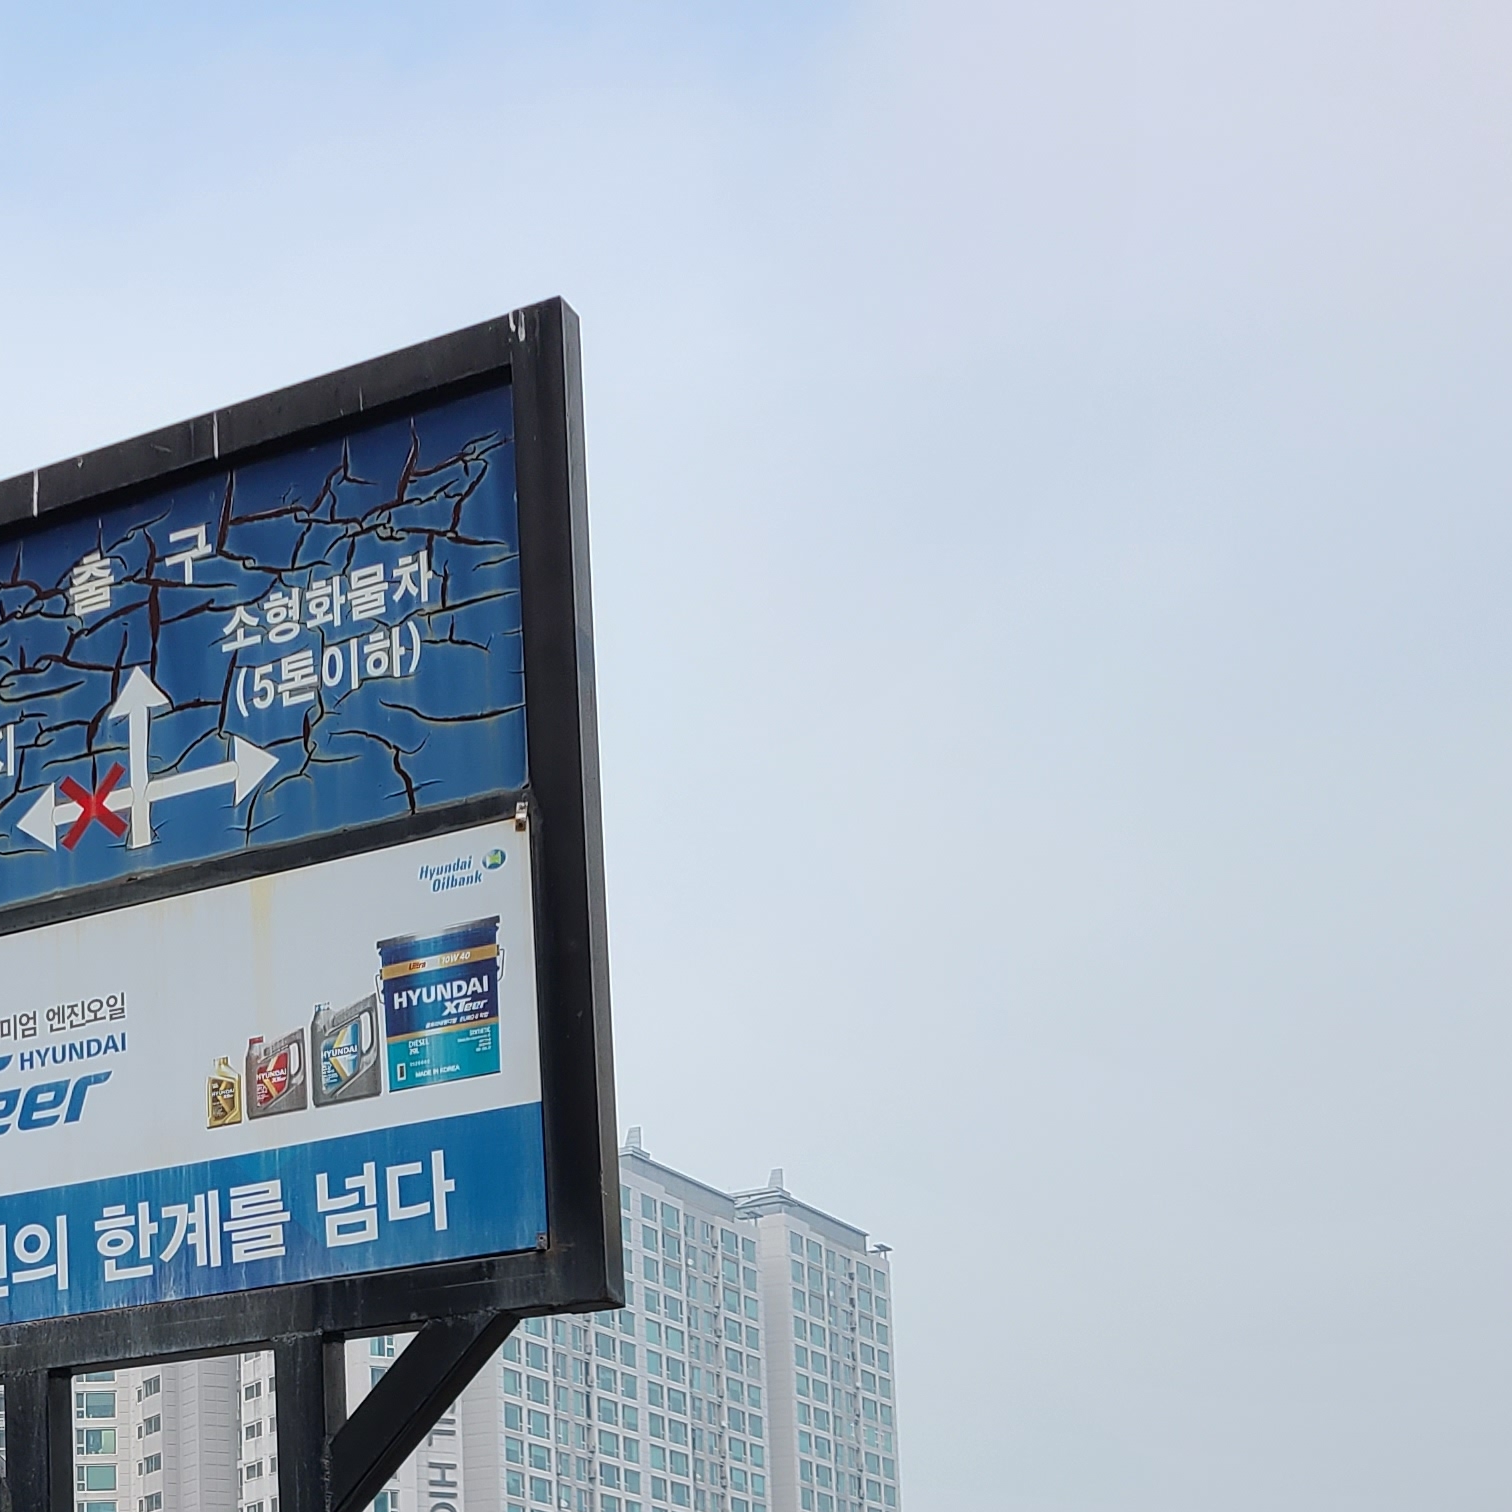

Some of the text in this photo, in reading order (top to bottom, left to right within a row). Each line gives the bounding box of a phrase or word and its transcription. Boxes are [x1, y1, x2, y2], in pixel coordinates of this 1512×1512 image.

[221, 549, 433, 653] 소형화물차
[235, 620, 422, 716] (5톤이하)
[419, 855, 473, 881] Hyundai
[432, 869, 482, 892] Oilbank
[393, 974, 489, 1010] HYUNDAI
[45, 992, 127, 1033] 엔진오일
[19, 1032, 127, 1071] HYUNDAI
[323, 1045, 358, 1058] HYUNDAI
[95, 1177, 290, 1284] 한계를
[315, 1149, 456, 1248] 넘다
